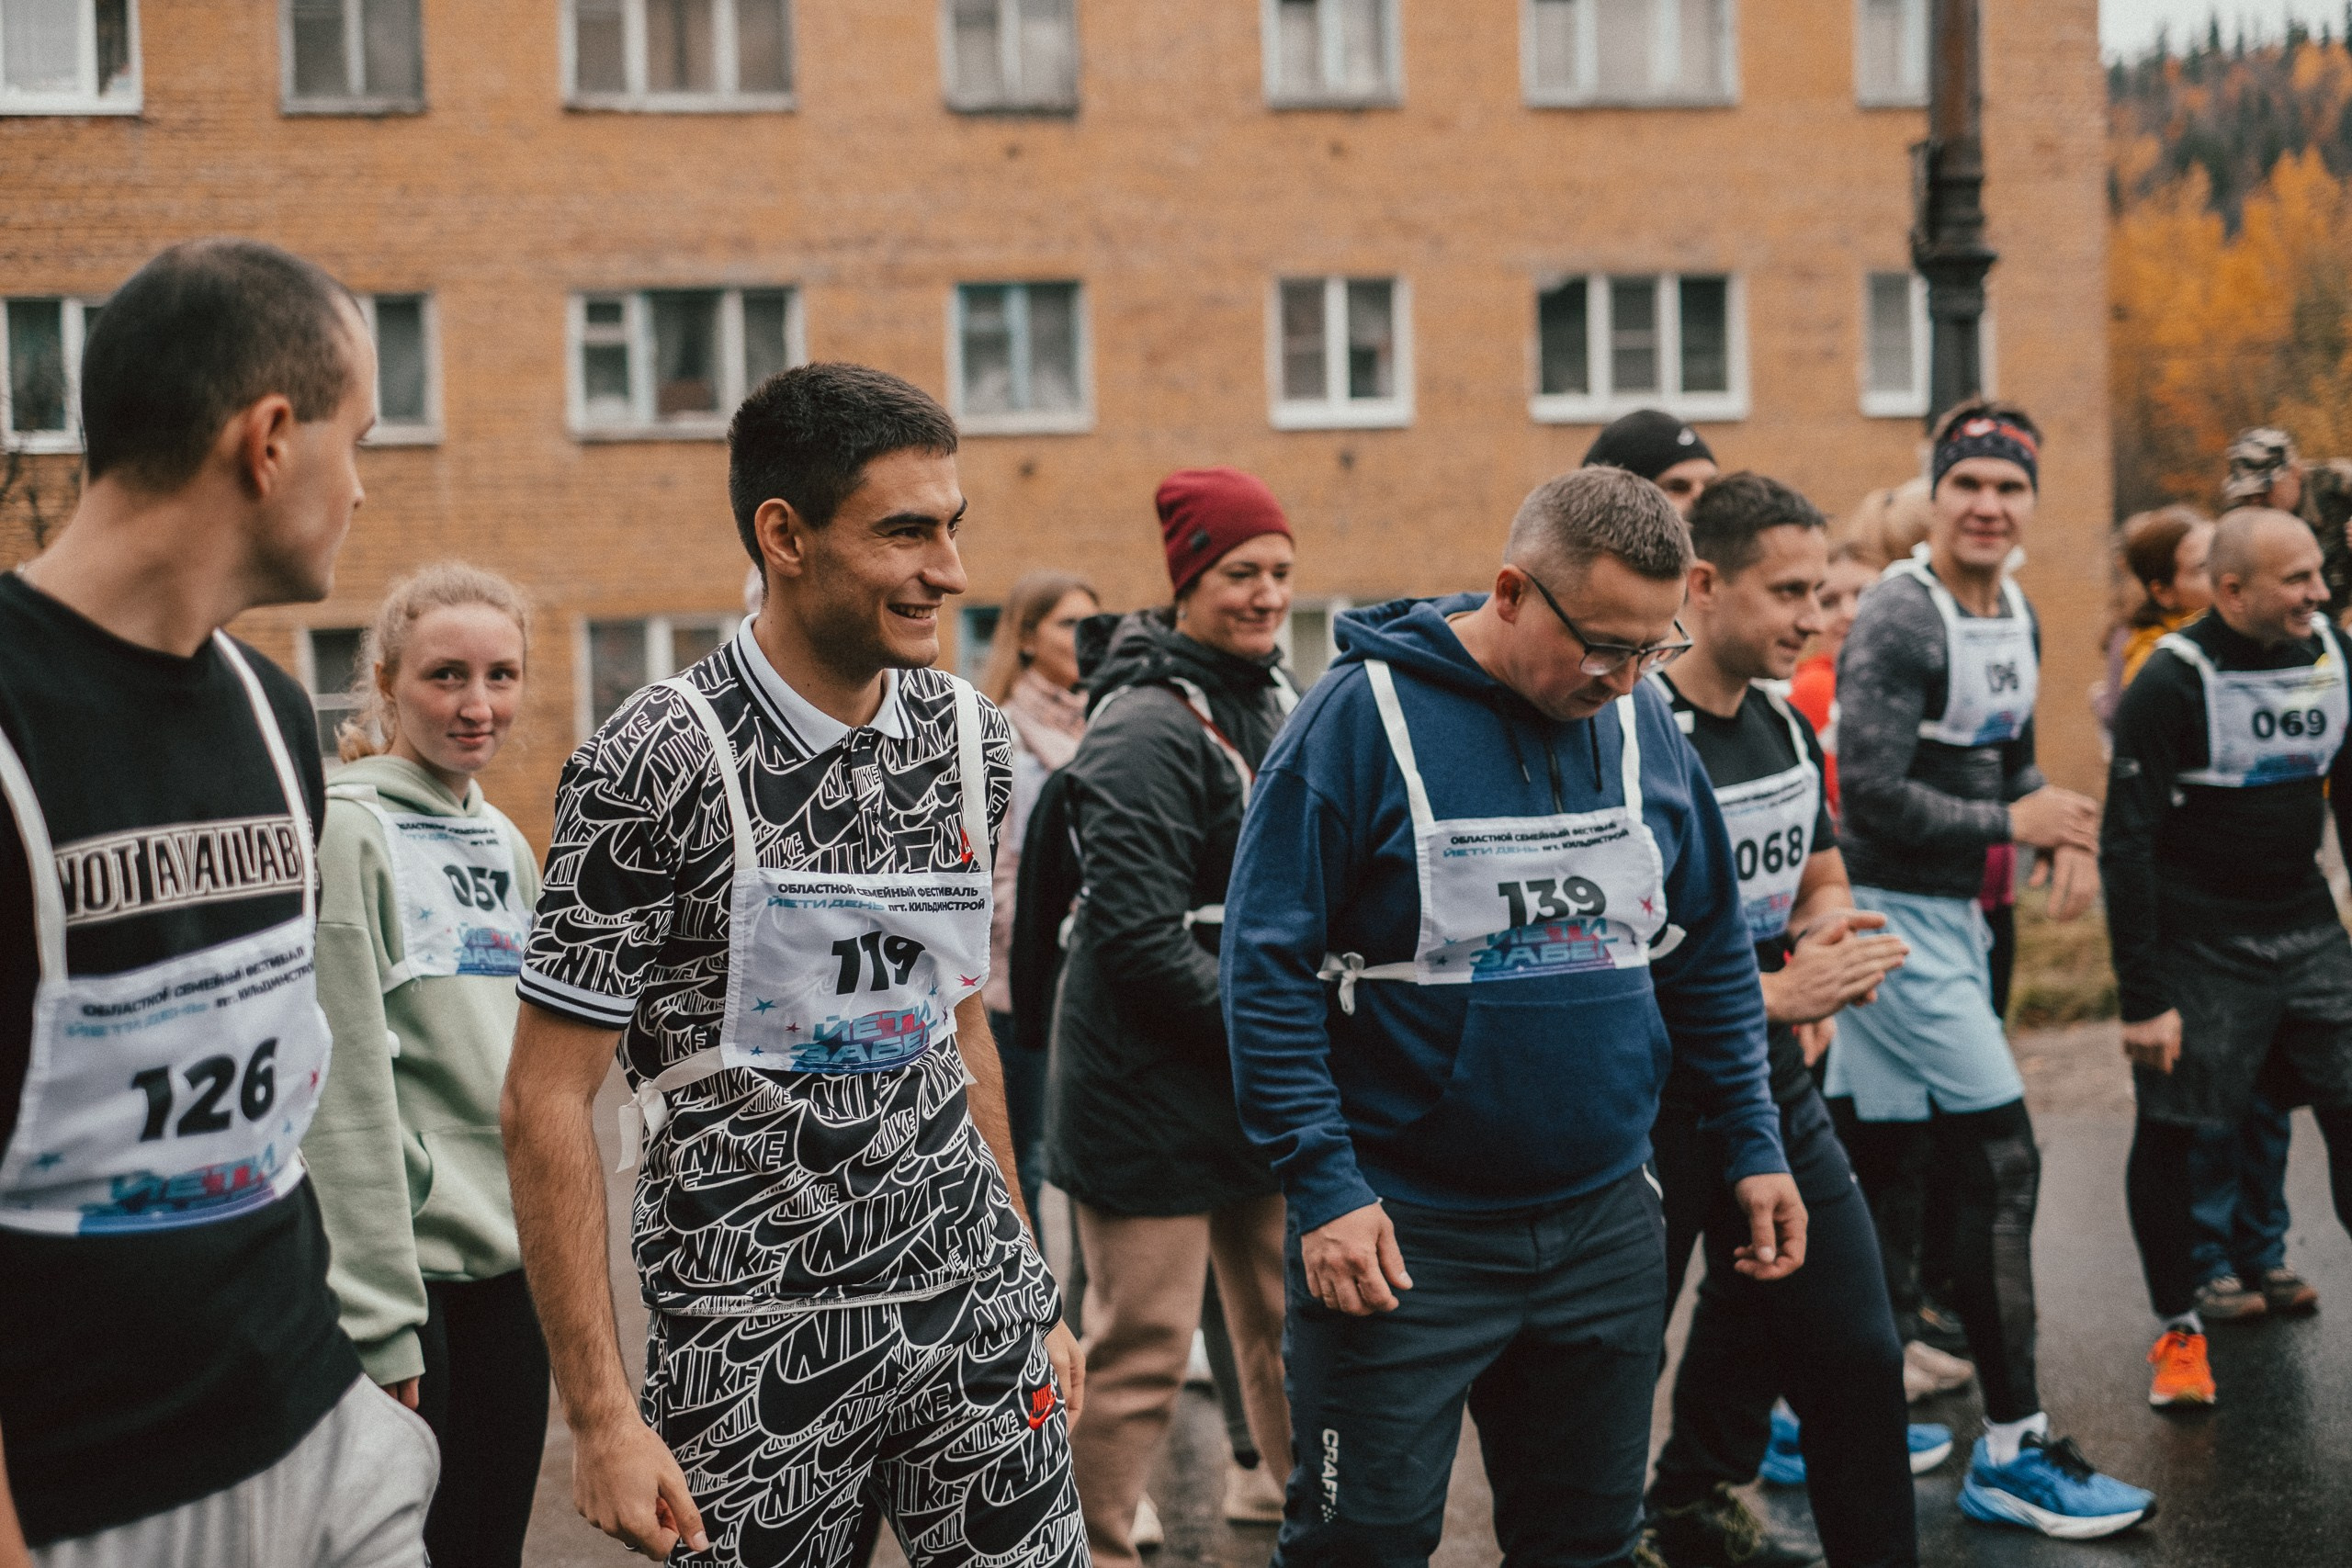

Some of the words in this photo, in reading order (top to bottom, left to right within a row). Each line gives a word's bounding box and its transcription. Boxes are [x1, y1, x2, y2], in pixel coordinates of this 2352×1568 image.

[2252, 708, 2327, 739] 069
[1443, 845, 1493, 859] ЙЕТИ
[1450, 831, 1513, 845] ОБЛАСТНОЙ
[1735, 825, 1804, 882] 068
[147, 824, 305, 901] AVAILAB
[442, 864, 511, 912] 057
[767, 896, 827, 909] ЙЕТИ
[828, 899, 886, 911] ДЕНЬ
[909, 898, 986, 913] КИЛЬДИНСТРОЙ
[777, 883, 856, 895] ОБЛАСТНОЙ
[856, 886, 917, 898] СЕМЕЙНЫЙ
[917, 886, 978, 897] ФЕСТИВАЛЬ
[1498, 875, 1607, 929] 139
[831, 930, 927, 996] 119
[1469, 936, 1619, 967] ЗАБЕГ
[789, 1018, 938, 1064] ЗАБЕГ
[812, 998, 933, 1043] ЙЕТИ
[131, 1036, 279, 1143] 126
[680, 1129, 787, 1177] NIKE
[872, 1106, 917, 1157] NIKE
[776, 1183, 840, 1218] NIKE
[1032, 1383, 1056, 1413] NIKE
[952, 1409, 1022, 1454] NIKE
[1320, 1427, 1340, 1506] CRAFT
